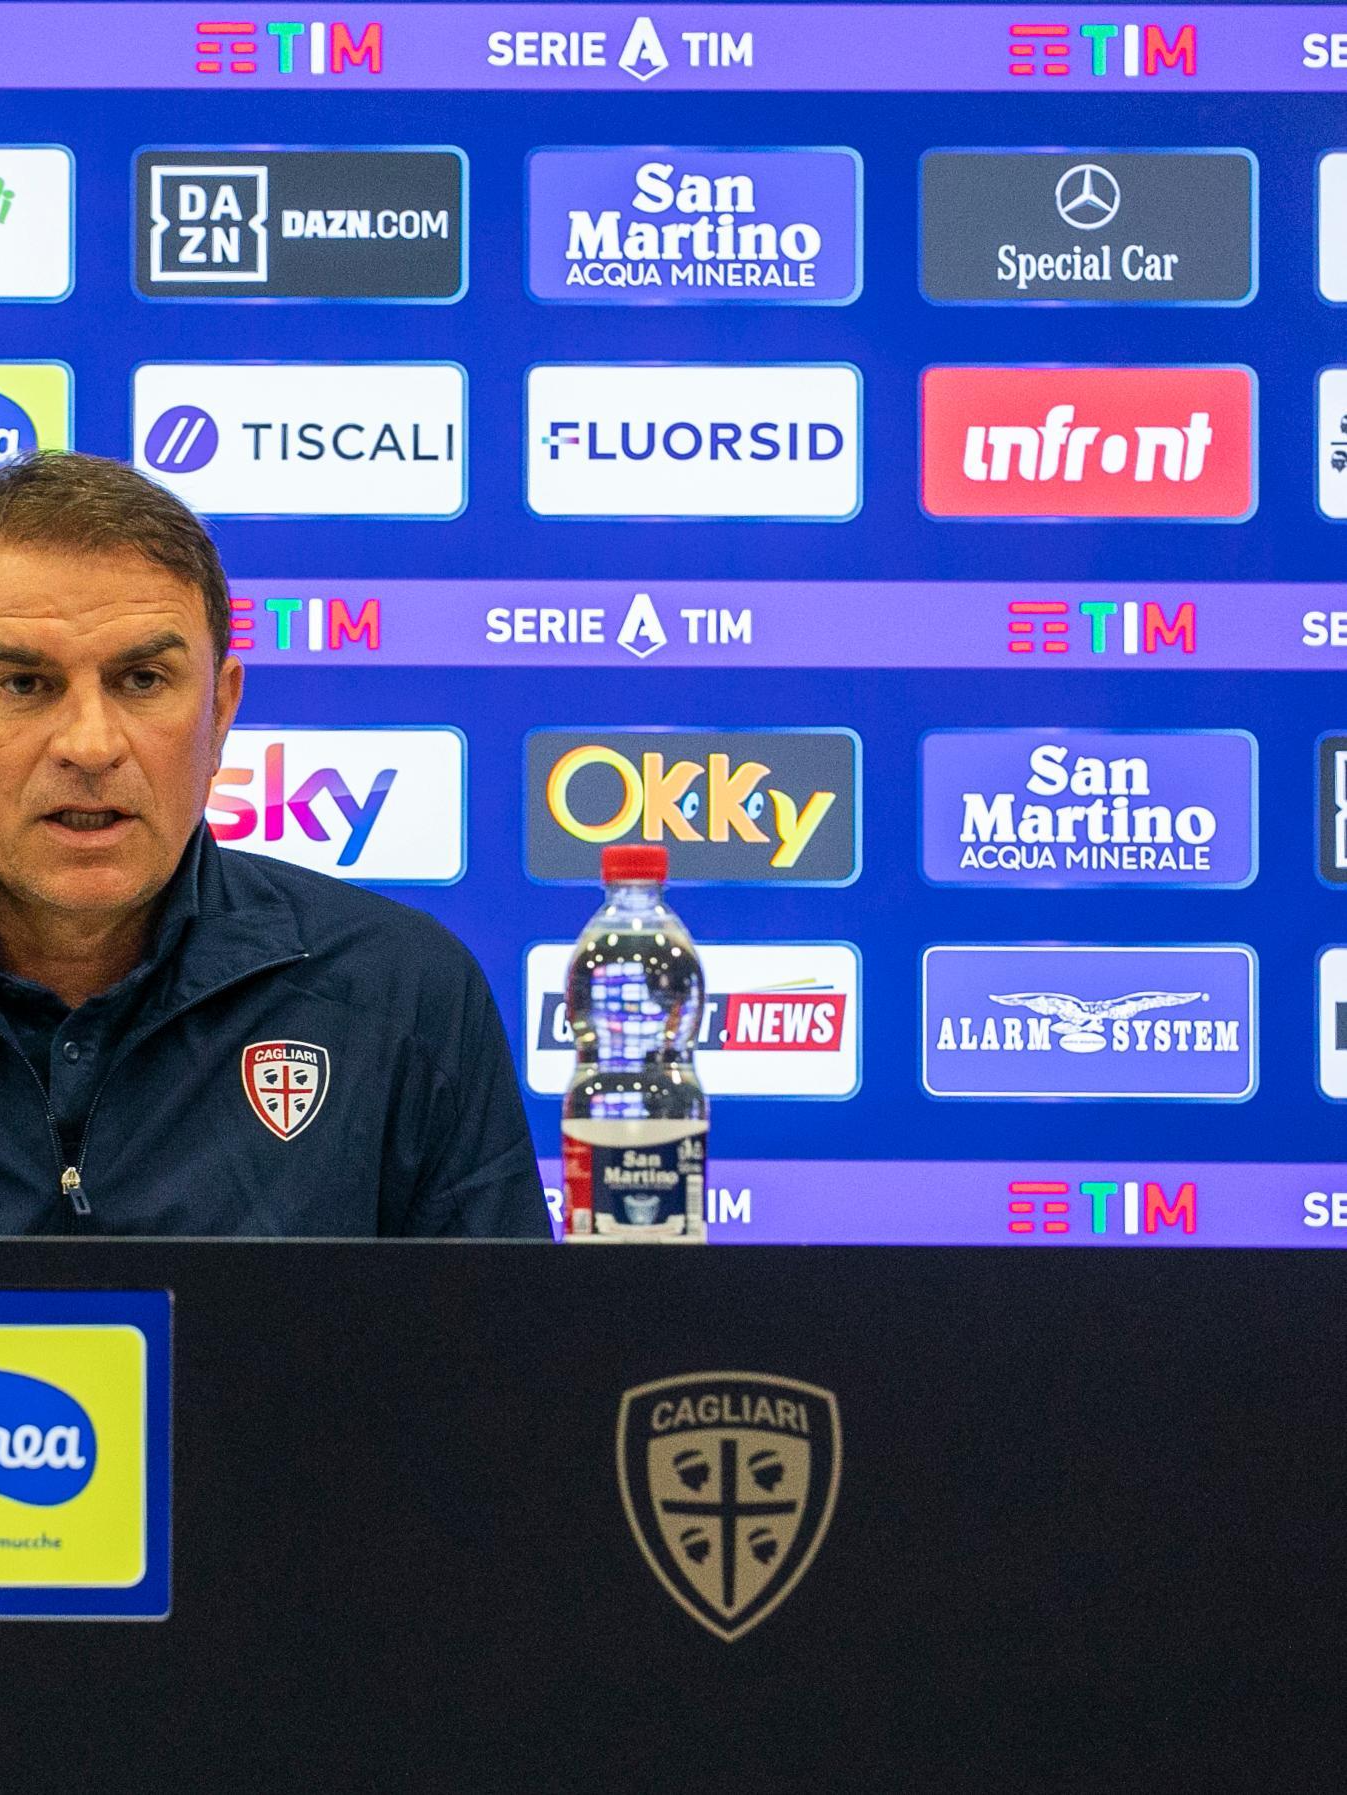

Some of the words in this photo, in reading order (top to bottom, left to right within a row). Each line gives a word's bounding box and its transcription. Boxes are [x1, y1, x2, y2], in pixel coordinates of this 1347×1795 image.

[266, 21, 383, 75] TIM
[487, 31, 606, 67] SERIE
[618, 16, 669, 81] A
[682, 32, 754, 67] TIM
[1080, 24, 1197, 76] TIM
[632, 163, 756, 213] San
[281, 210, 449, 239] DAZN.COM
[565, 211, 822, 261] Martino
[565, 262, 662, 288] ACQUA
[670, 263, 815, 288] MINERALE
[997, 244, 1112, 289] Special
[1121, 245, 1179, 281] Car
[242, 422, 455, 461] TISCALI
[548, 421, 844, 461] FLUORSID
[963, 405, 1212, 482] infront
[265, 598, 381, 652] TIM
[485, 607, 604, 643] SERIE
[616, 593, 667, 659] A
[680, 608, 752, 644] TIM
[1079, 601, 1197, 655] TIM
[1026, 744, 1150, 797] San
[206, 742, 398, 866] sky
[959, 792, 1217, 845] Martino
[959, 846, 1056, 872] ACQUA
[1065, 846, 1211, 871] MINERALE
[254, 1048, 318, 1065] CAGLIARI
[936, 1017, 1052, 1051] ALARM
[1112, 1018, 1240, 1052] SYSTEM
[604, 1166, 679, 1185] Martino
[622, 1150, 661, 1168] San
[707, 1188, 751, 1223] IM
[1079, 1181, 1197, 1235] TIM
[651, 1394, 810, 1433] CAGLIARI
